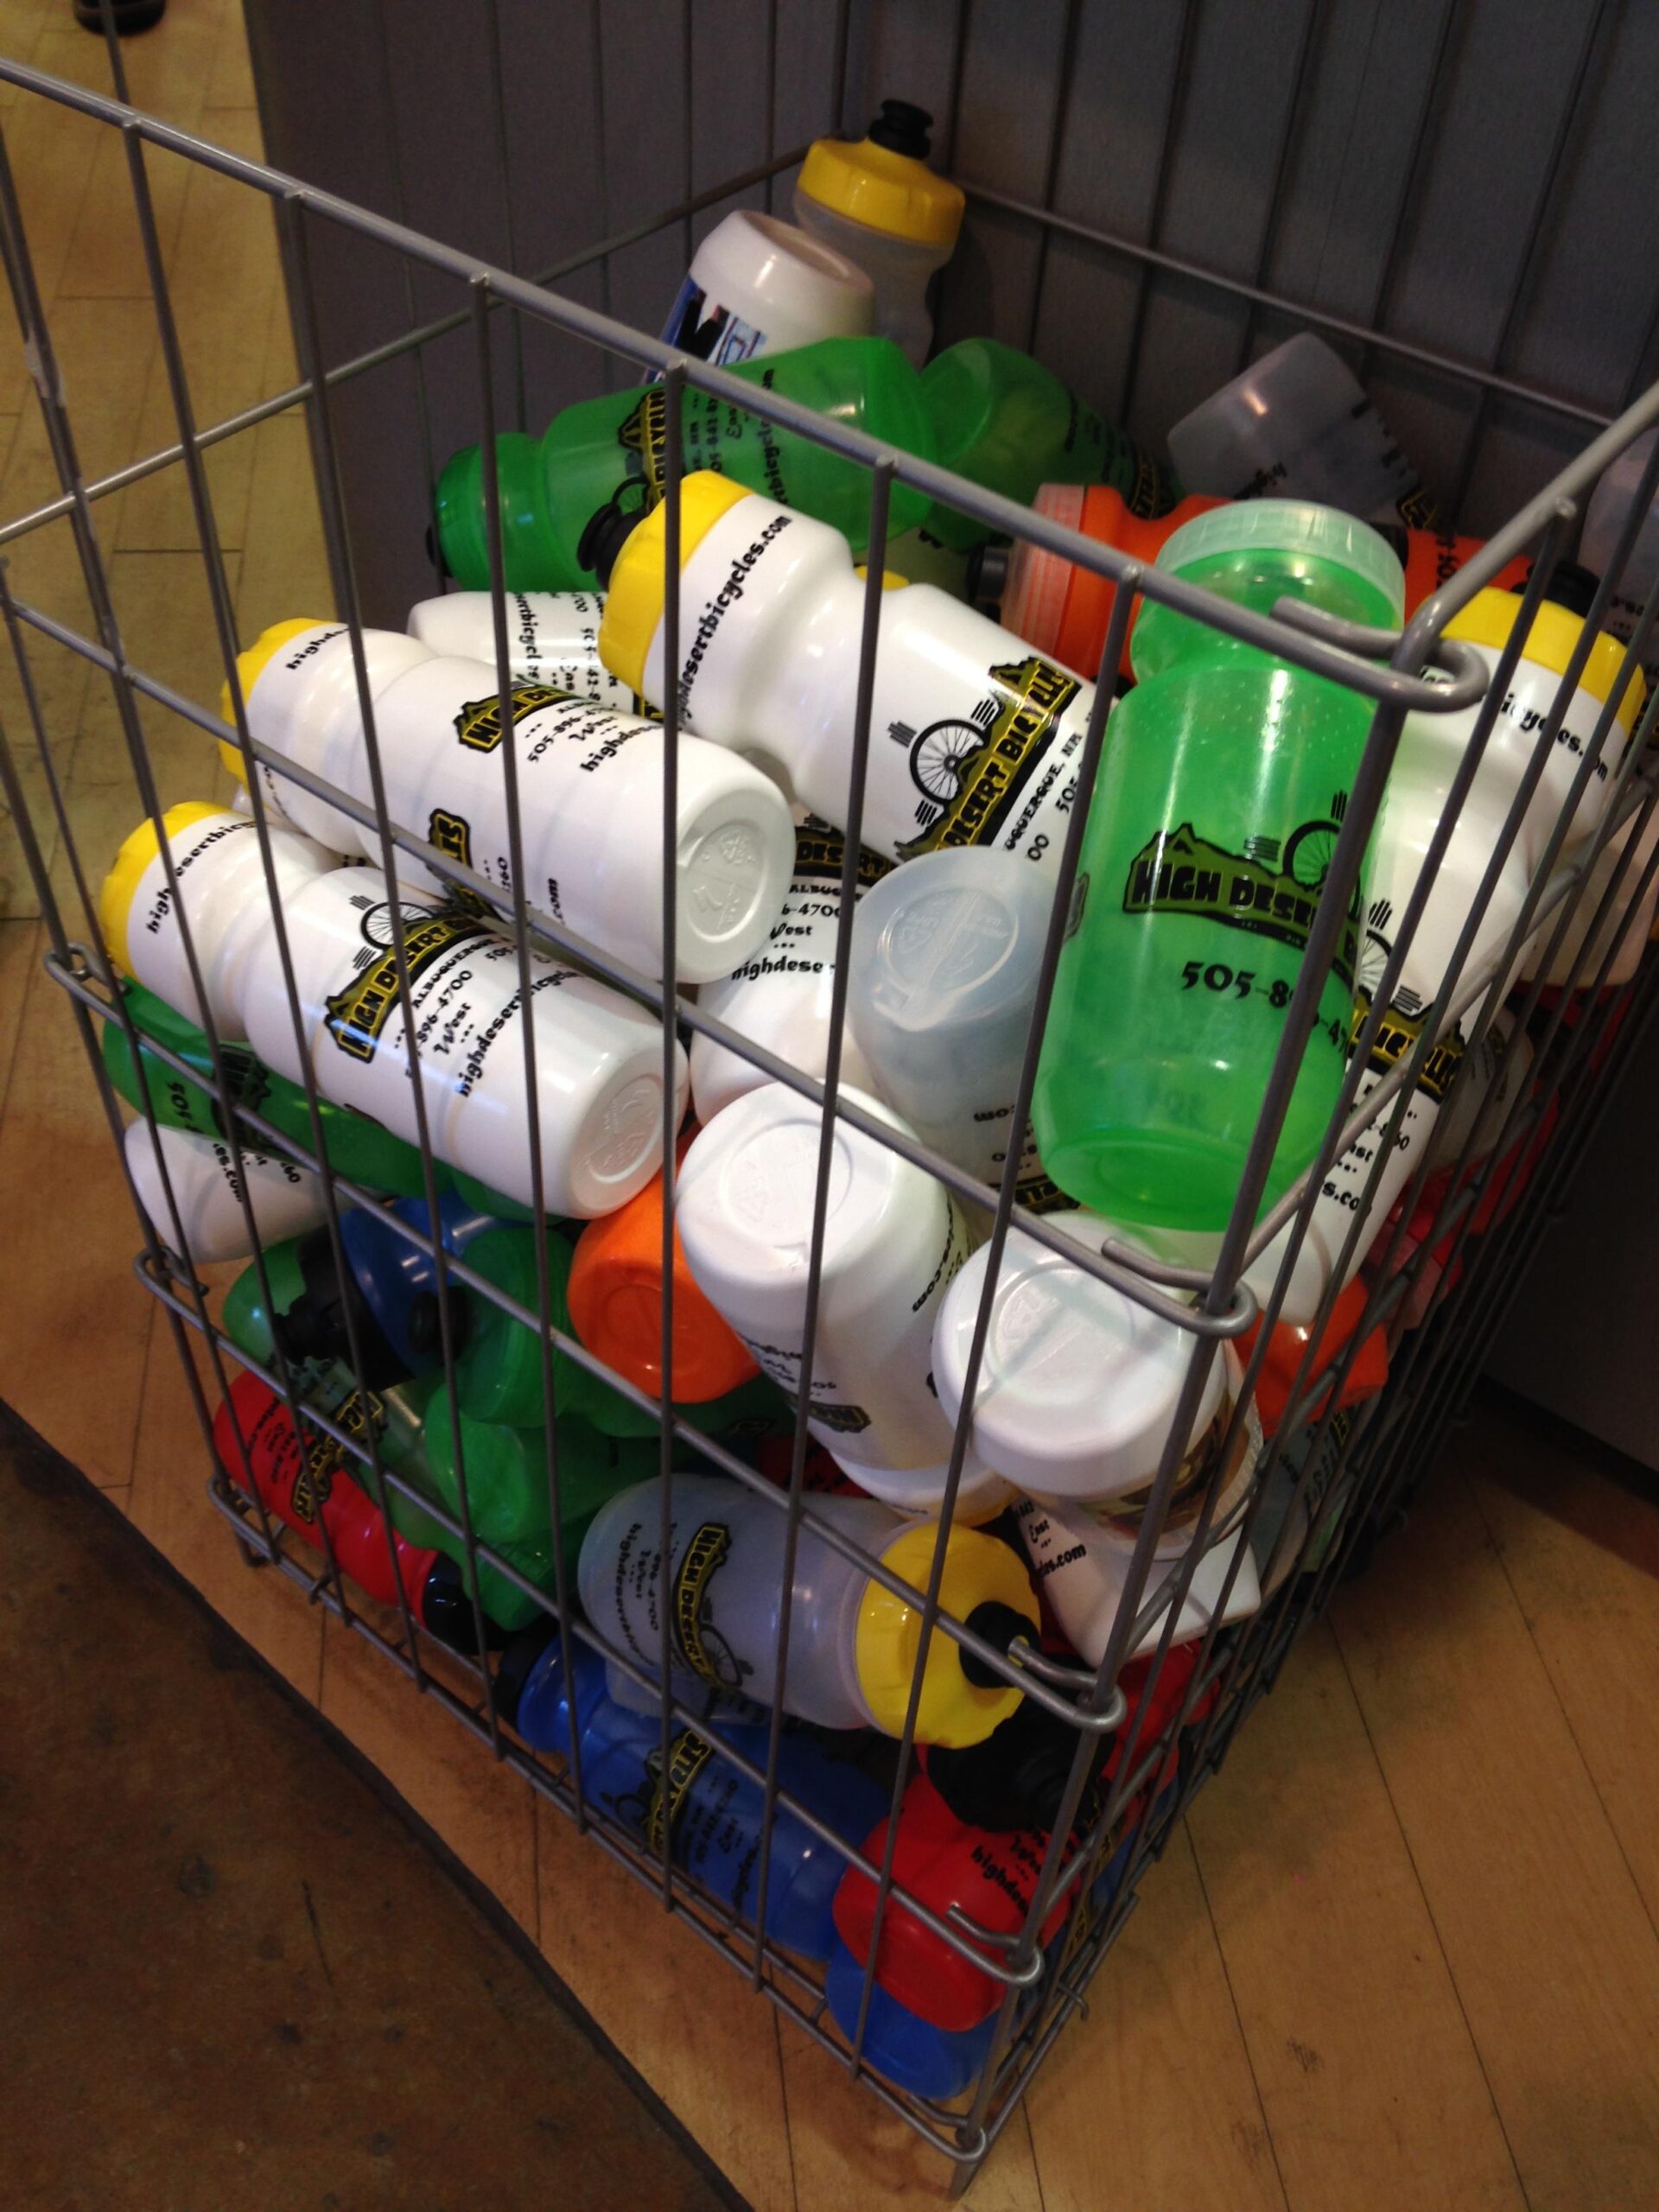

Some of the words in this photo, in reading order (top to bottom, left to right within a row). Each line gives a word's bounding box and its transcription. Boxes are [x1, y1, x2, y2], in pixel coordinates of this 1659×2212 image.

[1004, 763, 1066, 852] UQUERQUE,
[1131, 860, 1222, 904] HIGH
[1229, 874, 1316, 927] DESE
[340, 989, 387, 1057] HIGH
[433, 1001, 473, 1055] West
[683, 1525, 726, 1585] HIGH
